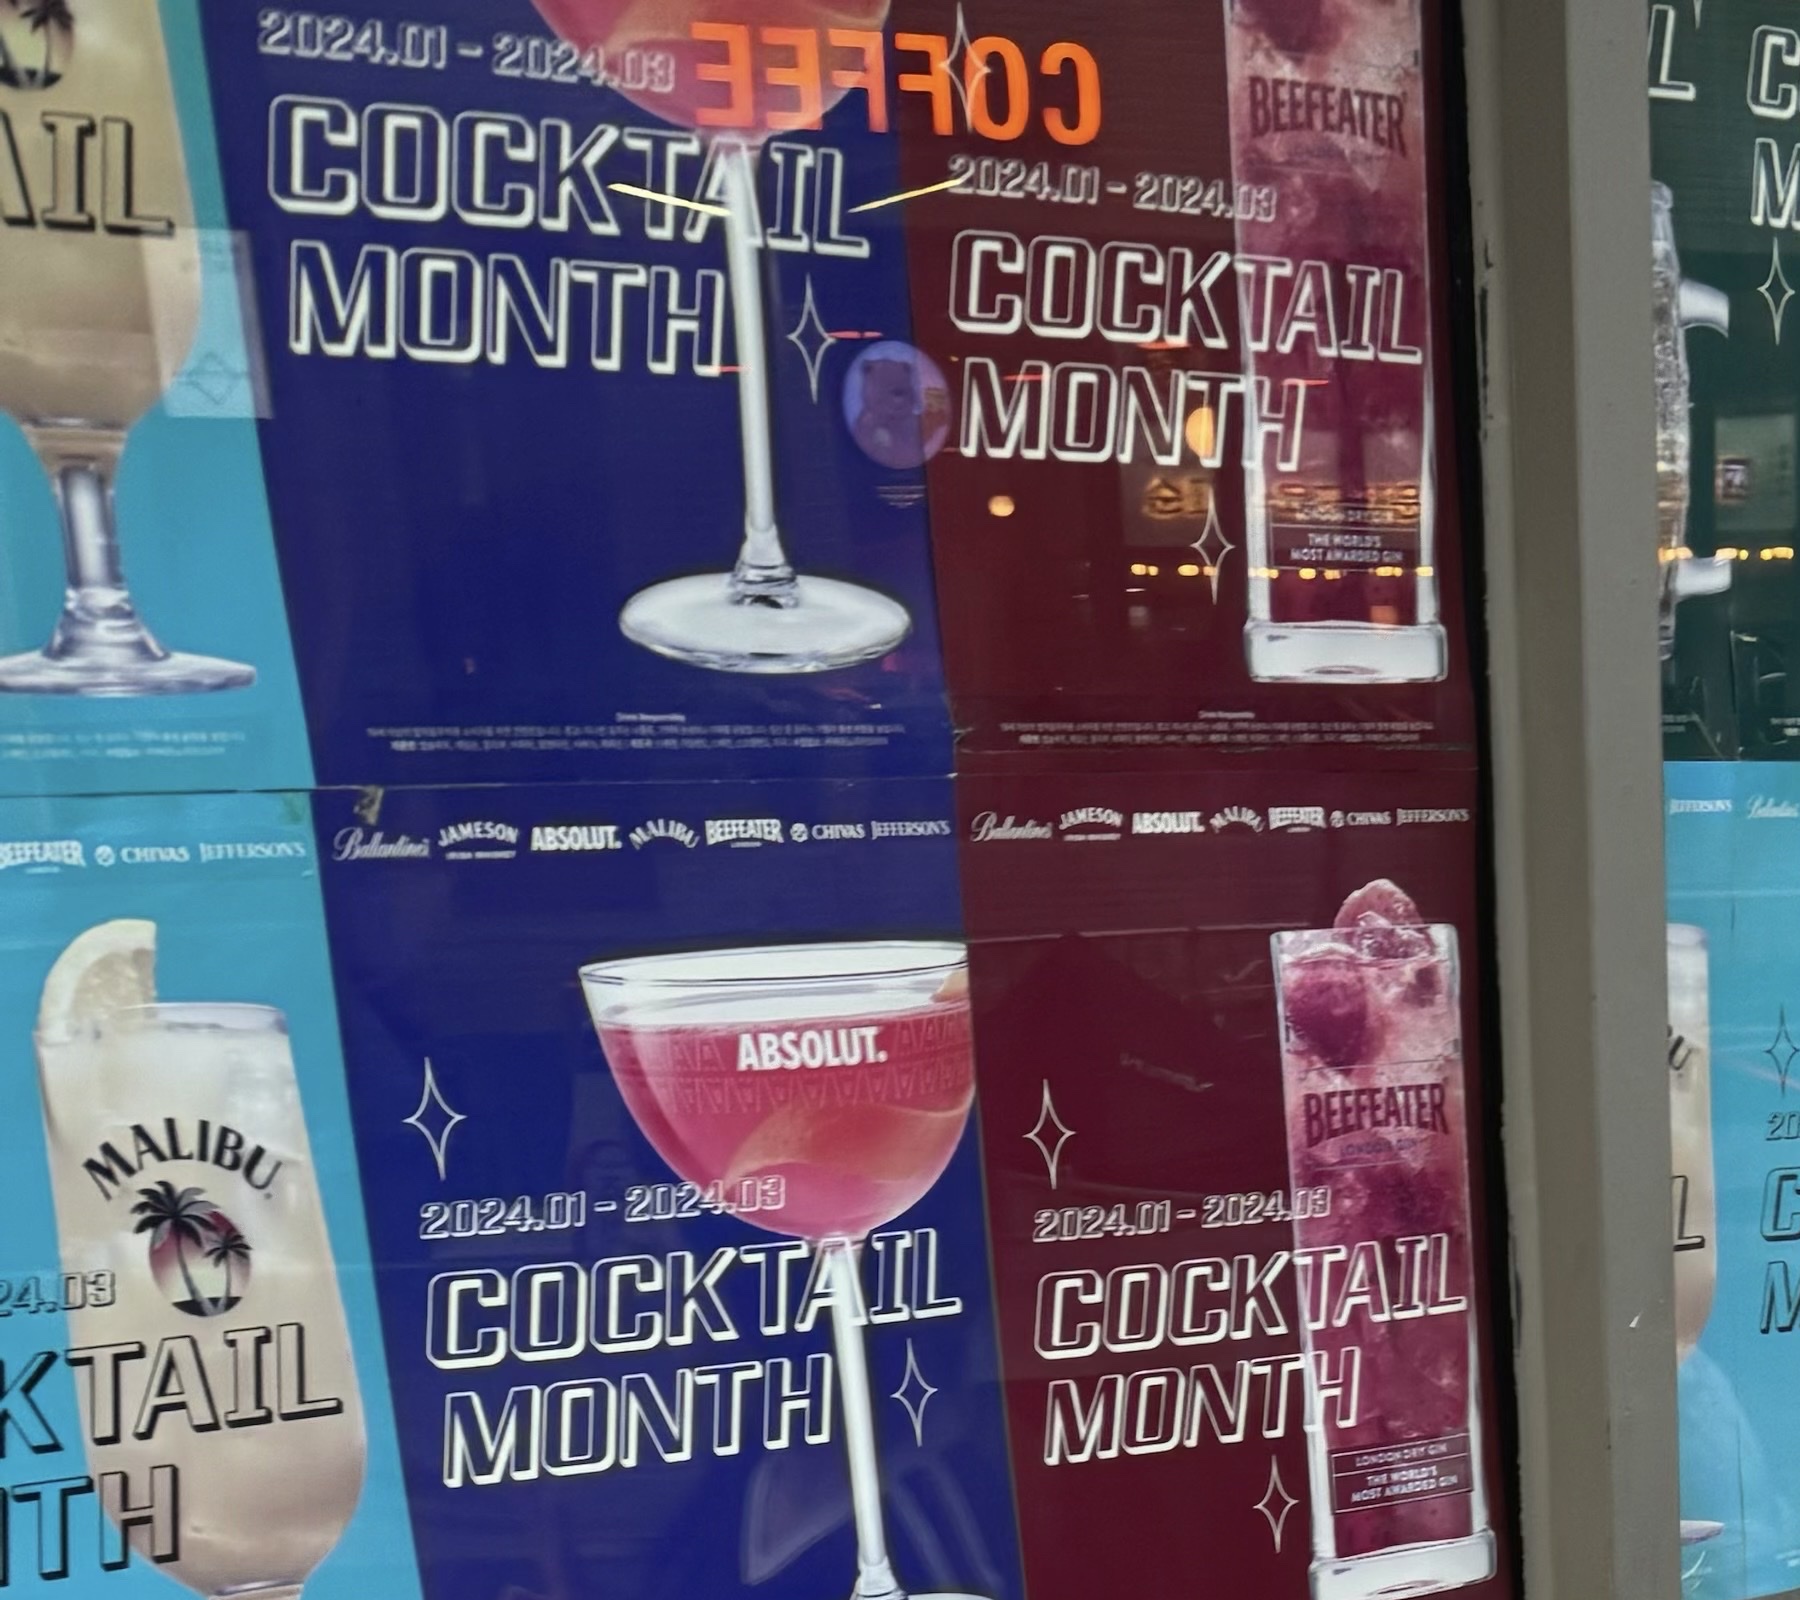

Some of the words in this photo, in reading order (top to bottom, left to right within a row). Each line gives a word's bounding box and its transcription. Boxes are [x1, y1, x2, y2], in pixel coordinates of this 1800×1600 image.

[257, 8, 448, 70] 2024.01
[492, 34, 675, 93] 2024.03
[1249, 74, 1406, 156] BEEFEATER
[269, 94, 870, 259] COCKTAIL
[948, 155, 1099, 206] 2024.01
[1134, 171, 1276, 222] 2024.03
[290, 239, 724, 377] MONTH
[949, 229, 1424, 365] COCKTAIL
[959, 356, 1308, 472] MONTH
[438, 821, 519, 847] JAMESON
[628, 819, 699, 849] MALIBU
[812, 823, 865, 840] CHIVAS
[1059, 807, 1123, 830] JAMESON
[1304, 1083, 1449, 1148] BEEFEATER
[420, 1189, 586, 1240] 2024.01
[624, 1175, 785, 1222] 2024.03
[1033, 1200, 1170, 1243] 2024.01
[1201, 1187, 1331, 1228] 2024.03
[426, 1228, 963, 1370] COCKTAIL
[1034, 1233, 1468, 1360] COCKTAIL
[443, 1352, 832, 1488] MONTH
[1044, 1346, 1361, 1467] MONTH
